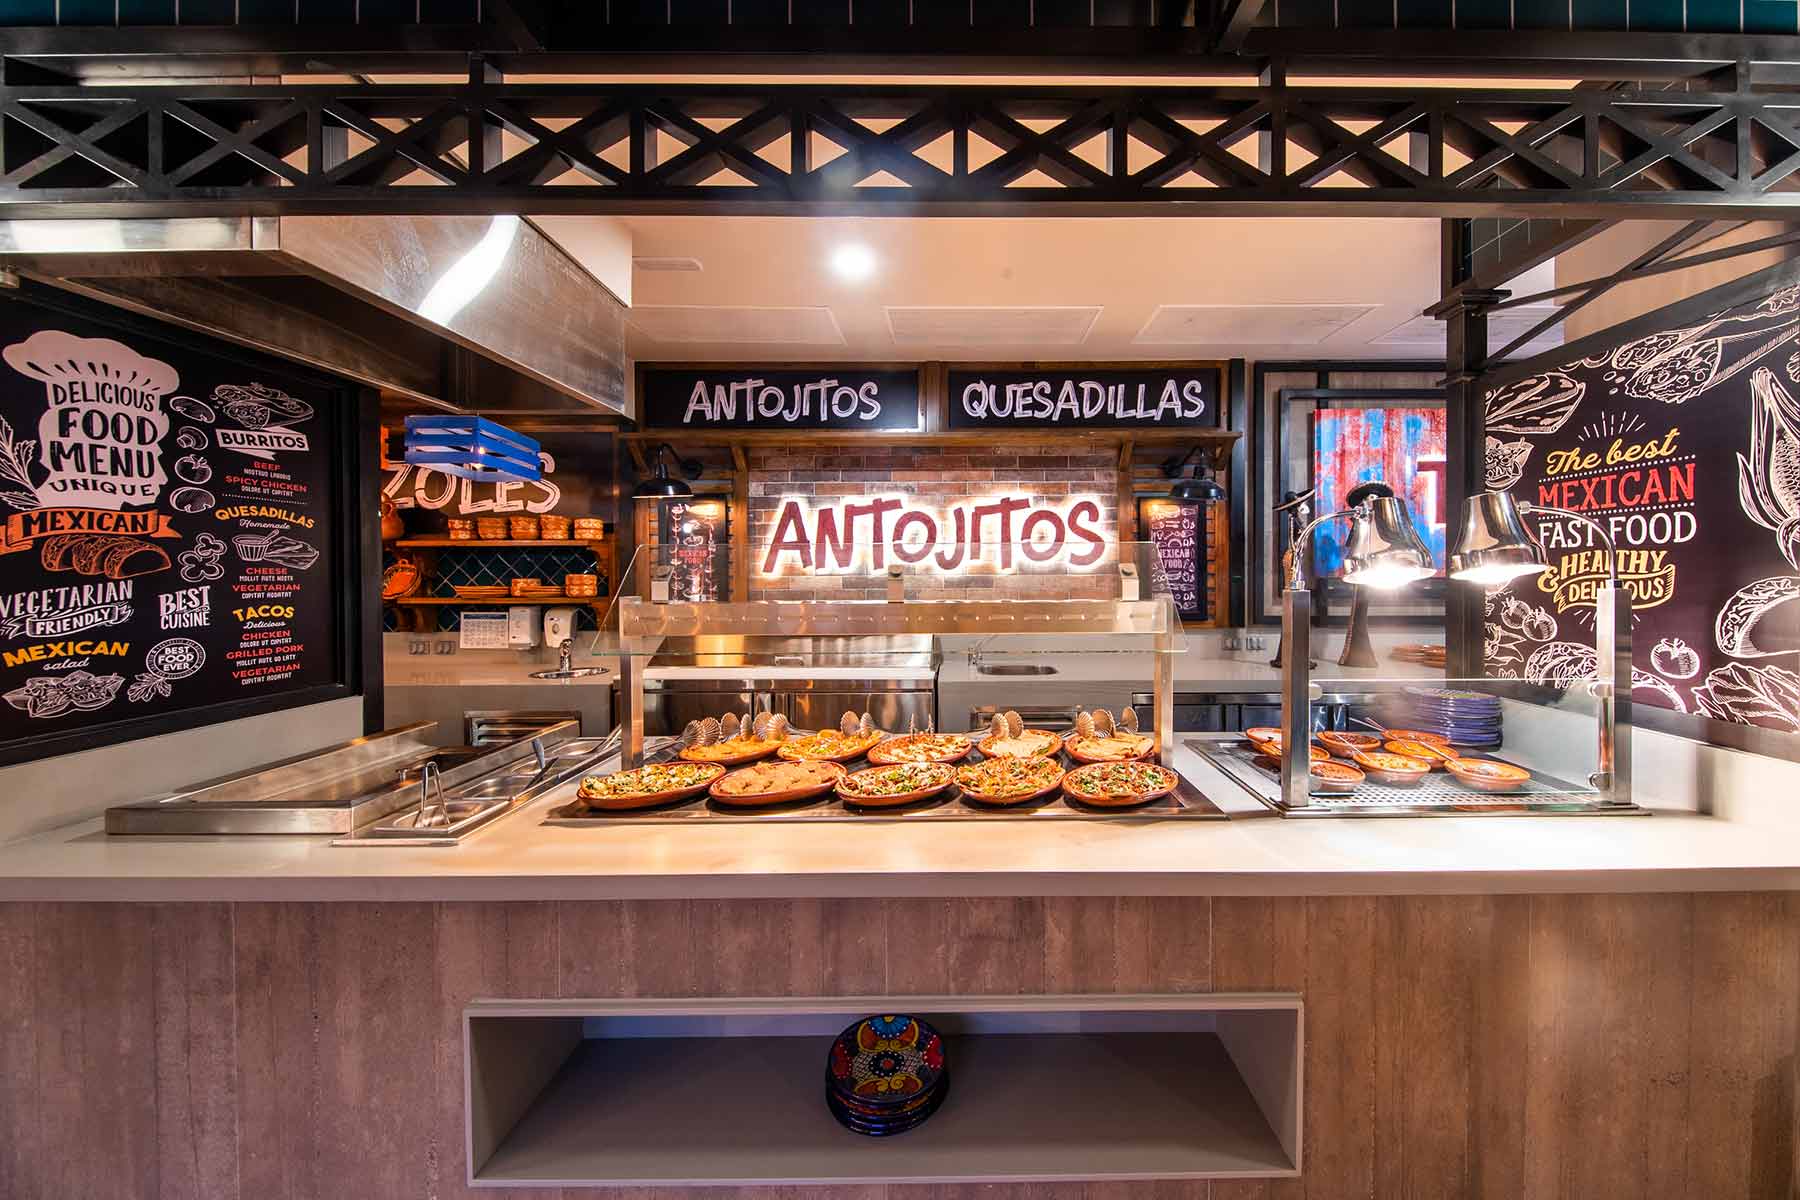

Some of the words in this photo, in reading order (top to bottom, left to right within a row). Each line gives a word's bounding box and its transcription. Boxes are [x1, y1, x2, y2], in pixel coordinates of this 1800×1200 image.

[53, 381, 155, 412] DELICIOUS
[683, 378, 881, 423] ANTOJITOS
[962, 379, 1205, 421] QUESADILLAS
[58, 407, 158, 446] FOOD
[221, 432, 305, 448] BURRITOS
[50, 441, 155, 479] MENU
[1546, 447, 1602, 475] The
[1606, 426, 1680, 465] best
[253, 461, 281, 471] BEEF
[48, 478, 155, 497] UNIQUE
[225, 475, 258, 486] SPICY
[261, 480, 308, 492] CHICKEN
[1538, 463, 1696, 515] MEXICAN
[22, 510, 149, 537] MEXICAN
[215, 506, 314, 528] QUESADILLAS
[239, 518, 291, 530] Homemade
[762, 497, 1106, 573] ANTOJITOS
[1538, 517, 1600, 548] FAST
[1609, 511, 1697, 545] FOOD
[245, 567, 288, 575] CHEESE
[232, 584, 300, 592] VEGETARIAN
[0, 579, 134, 618] VEGETARIAN
[158, 585, 211, 616] BEST
[35, 607, 111, 635] FRIENDLY
[160, 611, 211, 630] CUISINE
[232, 605, 295, 622] TACOS
[243, 620, 286, 630] Delicious
[242, 630, 290, 641] CHICKEN
[2, 641, 130, 668] MEXICAN
[158, 654, 194, 664] FOOD
[165, 646, 190, 655] BEST
[226, 648, 273, 659] GRILLED
[275, 644, 304, 654] PORK
[42, 657, 90, 671] salad
[163, 662, 190, 671] EVER
[232, 663, 300, 679] VEGETARIAN
